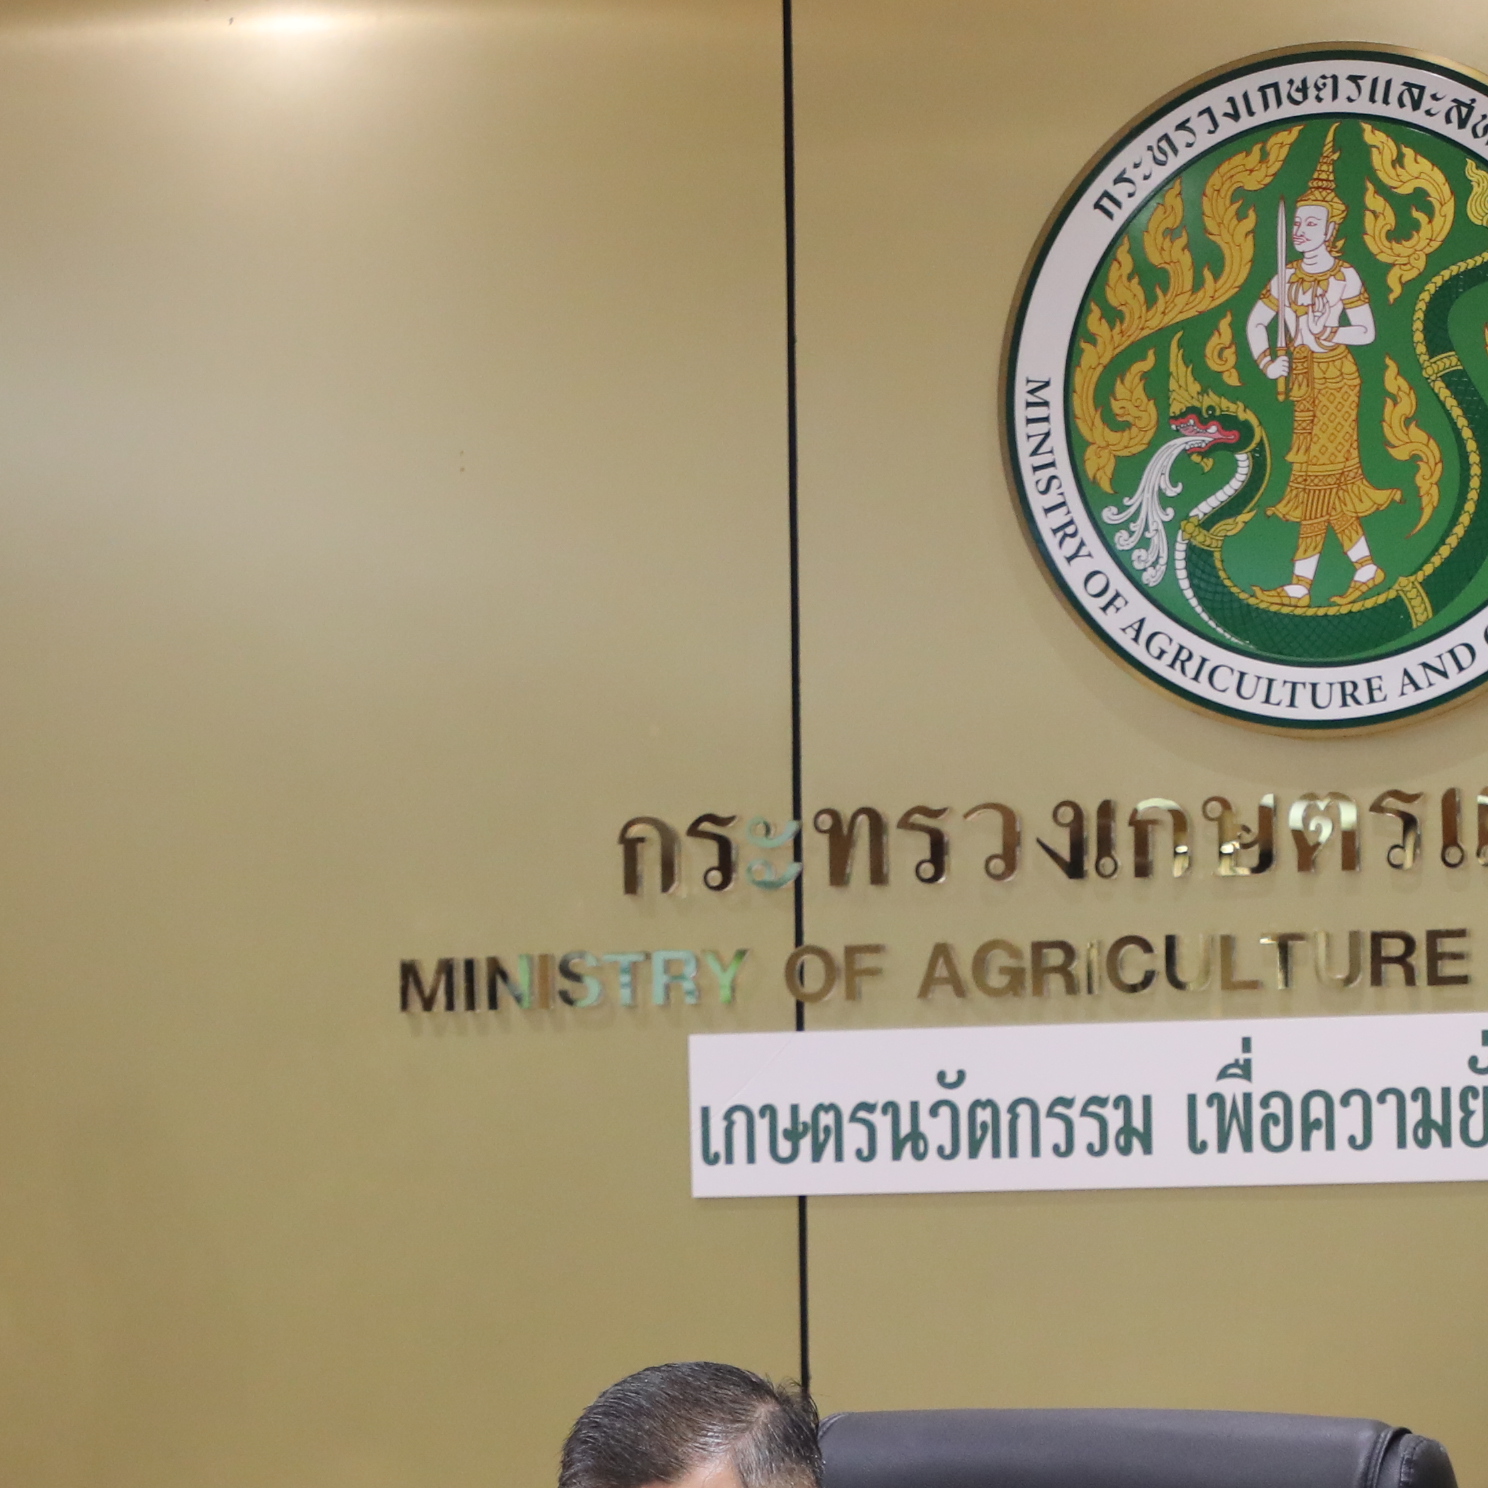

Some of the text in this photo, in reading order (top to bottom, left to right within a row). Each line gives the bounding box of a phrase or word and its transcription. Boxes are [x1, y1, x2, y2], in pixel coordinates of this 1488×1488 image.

[1023, 375, 1091, 567] MINISTRY
[1083, 567, 1128, 621] OF
[1120, 613, 1388, 709] AGRICULTURE
[1398, 641, 1477, 697] AND
[399, 948, 750, 1014] MINISTRY
[783, 943, 887, 1003] OF
[916, 928, 1472, 1000] AGRICULTURE
[699, 1068, 1154, 1167] เกษตรนวัตกรรม
